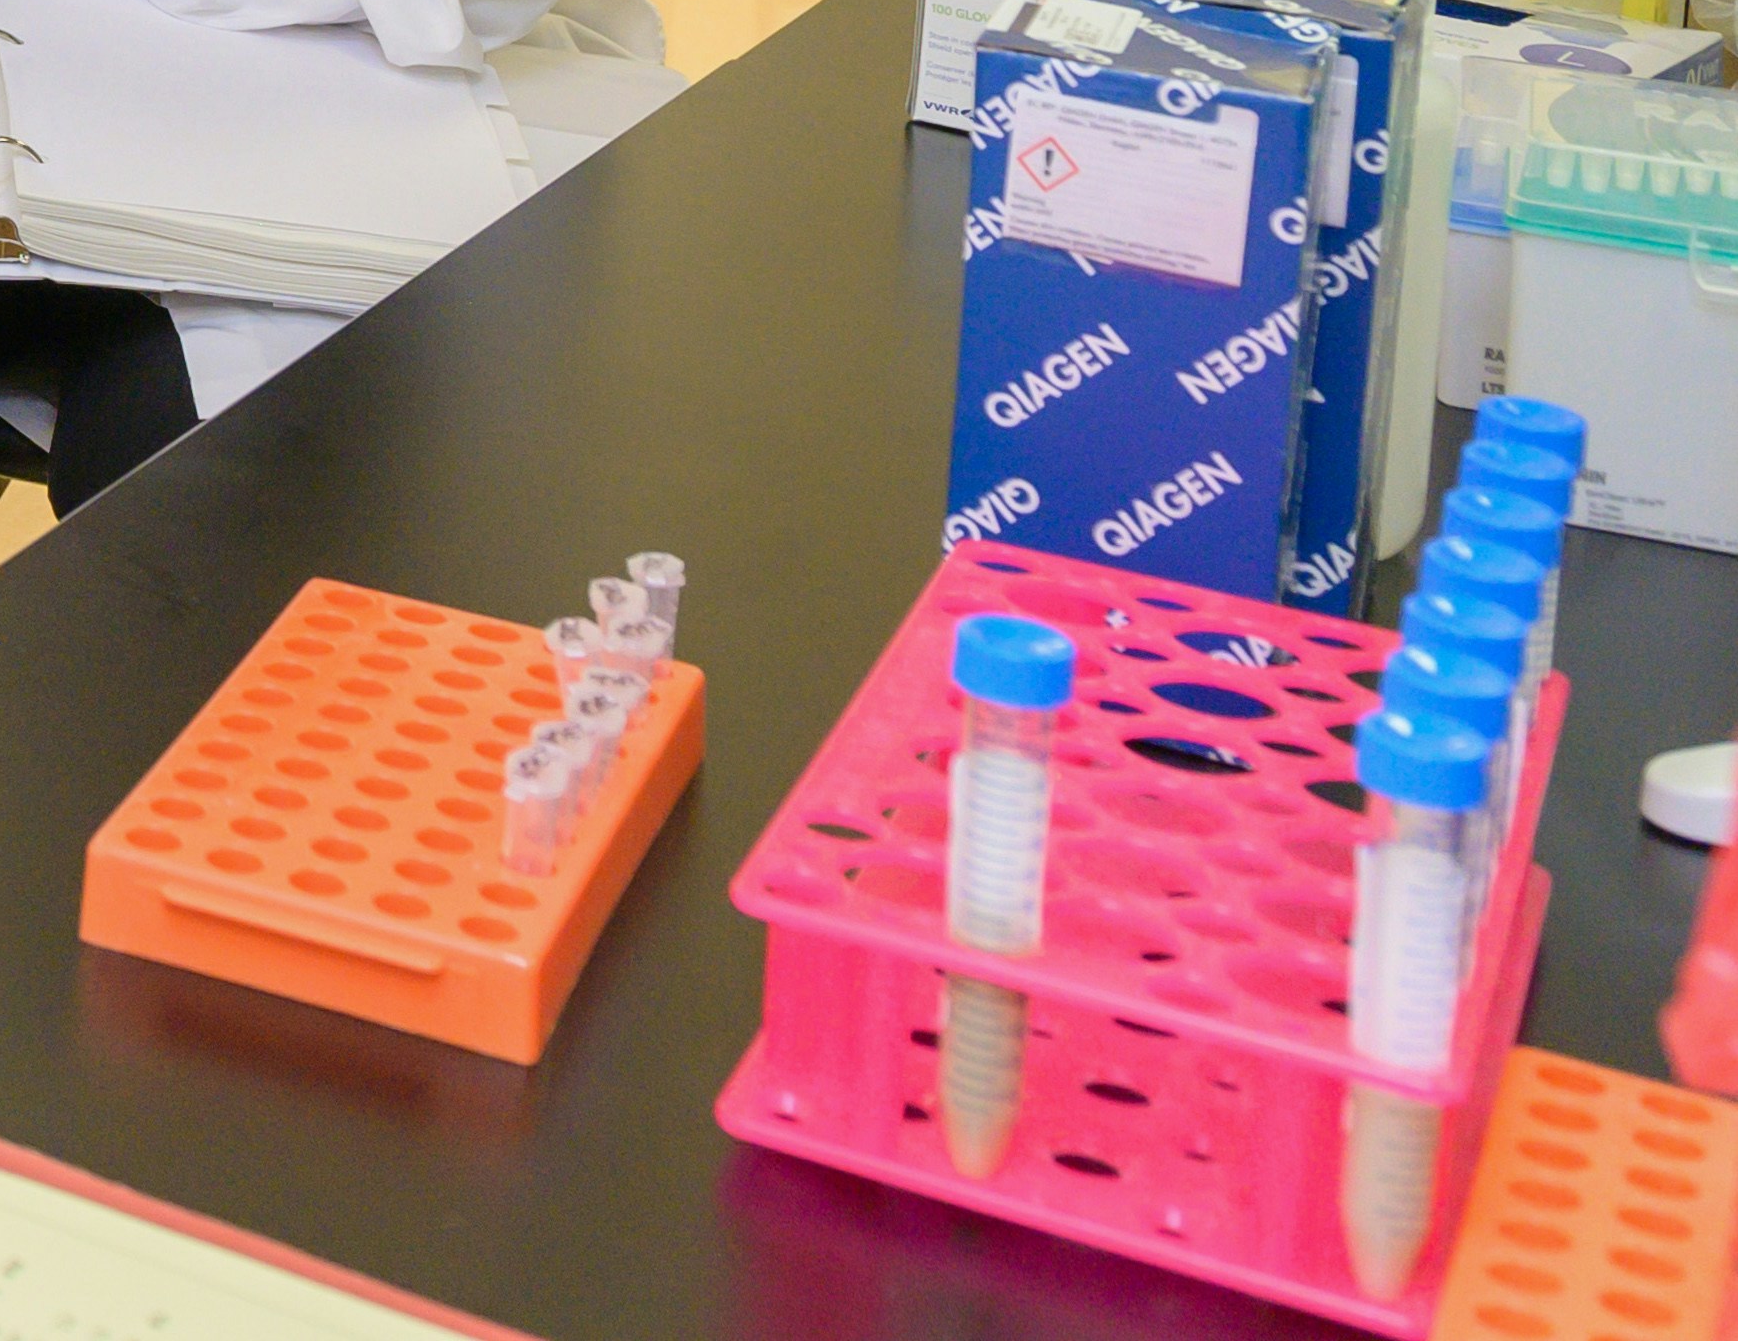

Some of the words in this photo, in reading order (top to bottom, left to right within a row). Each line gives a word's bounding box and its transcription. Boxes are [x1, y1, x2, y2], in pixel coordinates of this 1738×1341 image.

[931, 3, 953, 16] 100
[923, 100, 960, 115] VWR
[982, 322, 1133, 432] QIAGEN
[1092, 449, 1244, 561] QIAGEN
